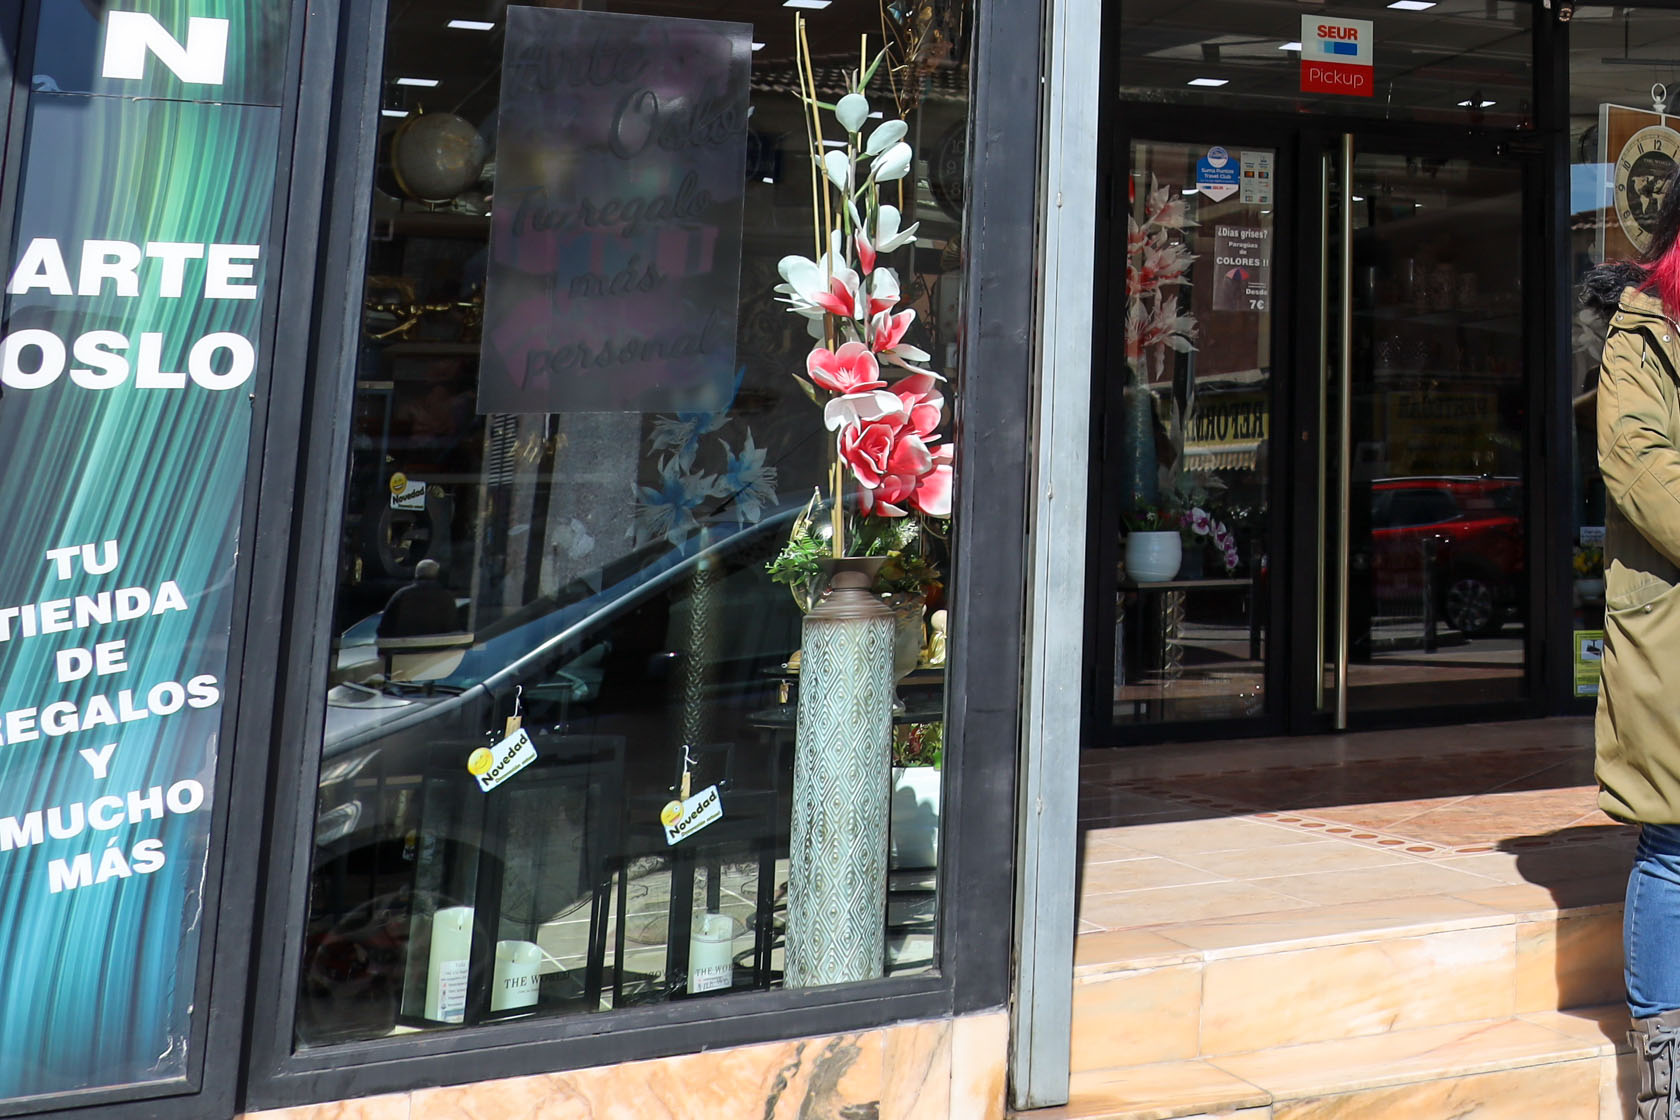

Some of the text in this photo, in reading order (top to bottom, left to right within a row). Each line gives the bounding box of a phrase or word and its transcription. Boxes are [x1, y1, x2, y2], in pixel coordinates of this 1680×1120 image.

[1316, 24, 1359, 41] SEUR
[1308, 67, 1364, 89] Pickup
[1653, 138, 1663, 151] 12
[1241, 228, 1268, 240] grises?
[6, 237, 261, 300] ARTE
[1216, 256, 1260, 267] COLORES
[1249, 299, 1265, 310] 7€
[0, 328, 255, 391] OSLO
[46, 539, 120, 581] TU
[0, 580, 188, 642] TIENDA
[56, 639, 129, 684] DE
[0, 673, 220, 747] EGALOS
[79, 742, 118, 780] Y
[481, 733, 529, 787] Novedad
[0, 779, 205, 852] MUCHO
[669, 790, 718, 840] Novedad
[48, 835, 166, 895] MÁS
[503, 976, 528, 990] THE
